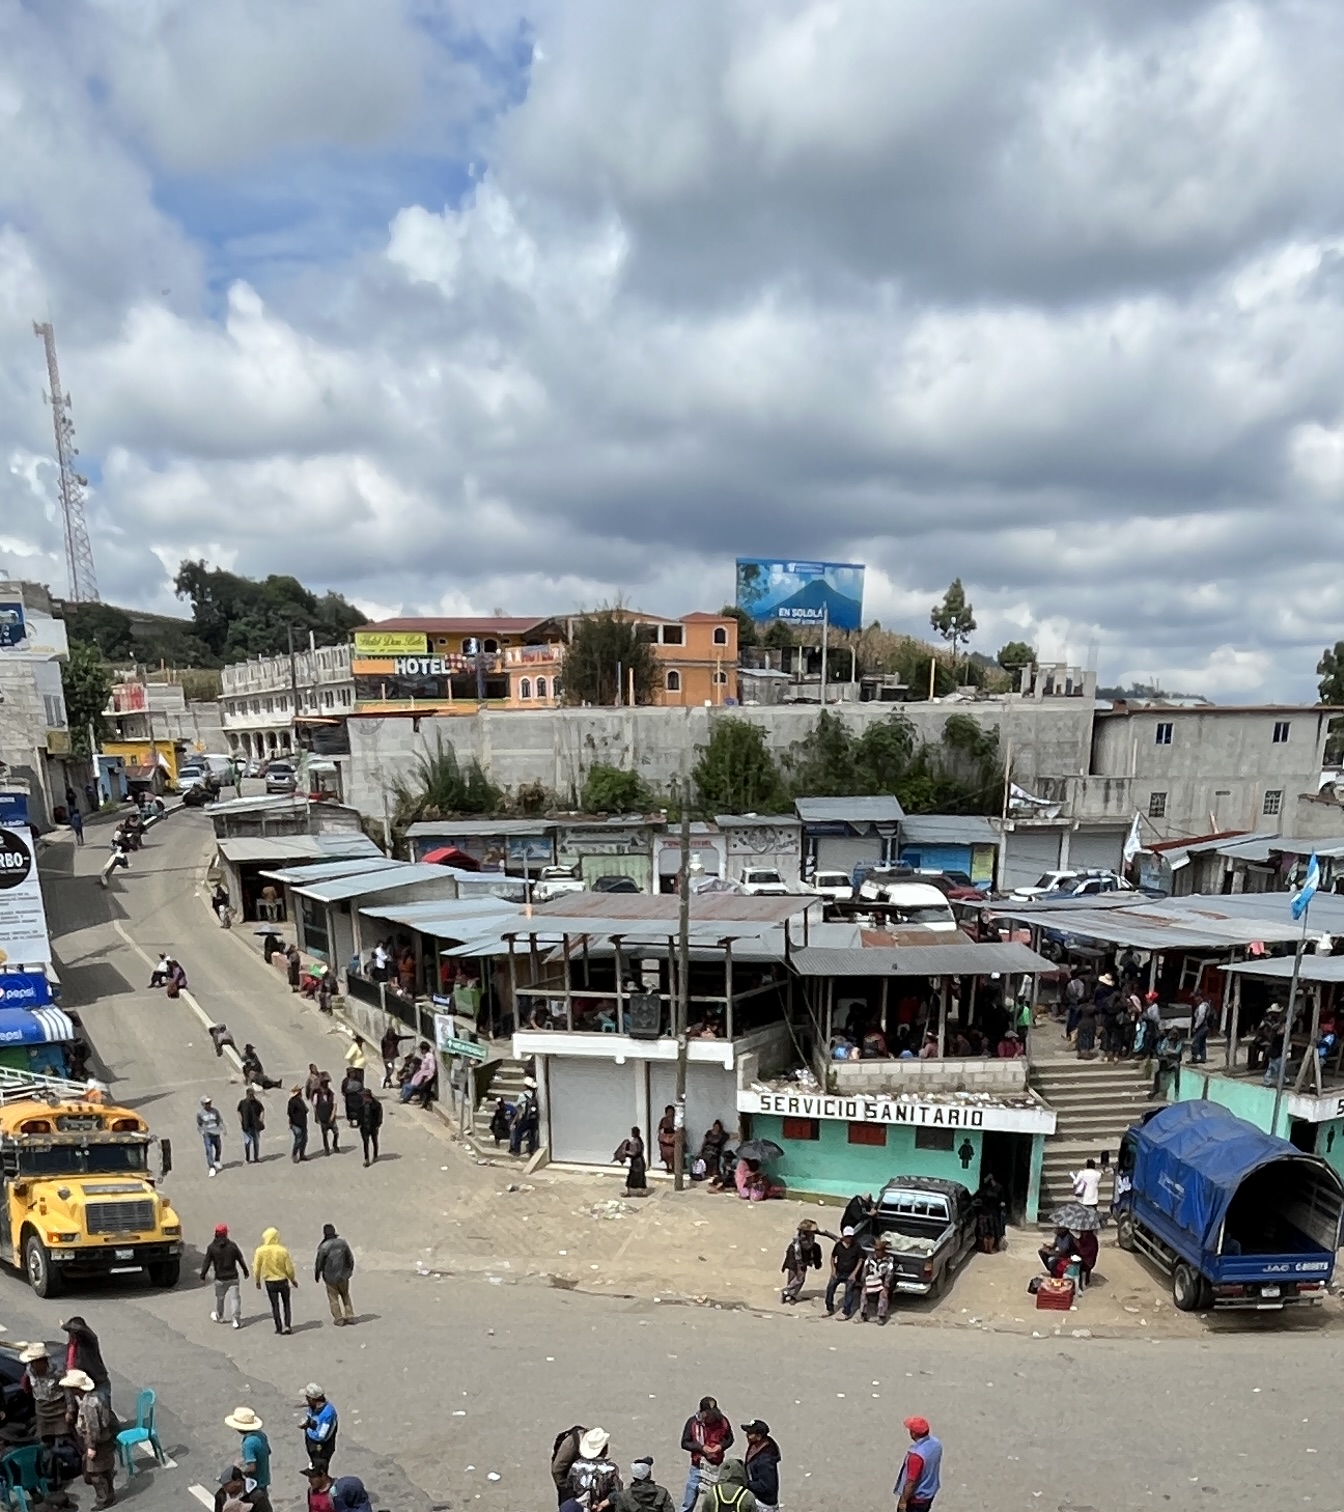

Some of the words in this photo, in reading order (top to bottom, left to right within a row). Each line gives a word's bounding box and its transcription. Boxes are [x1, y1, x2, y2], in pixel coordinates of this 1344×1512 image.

[395, 657, 451, 675] HOTEL
[6, 987, 34, 1001] pepsi
[760, 1095, 858, 1118] SERVICIO
[864, 1102, 984, 1127] SANITARIO
